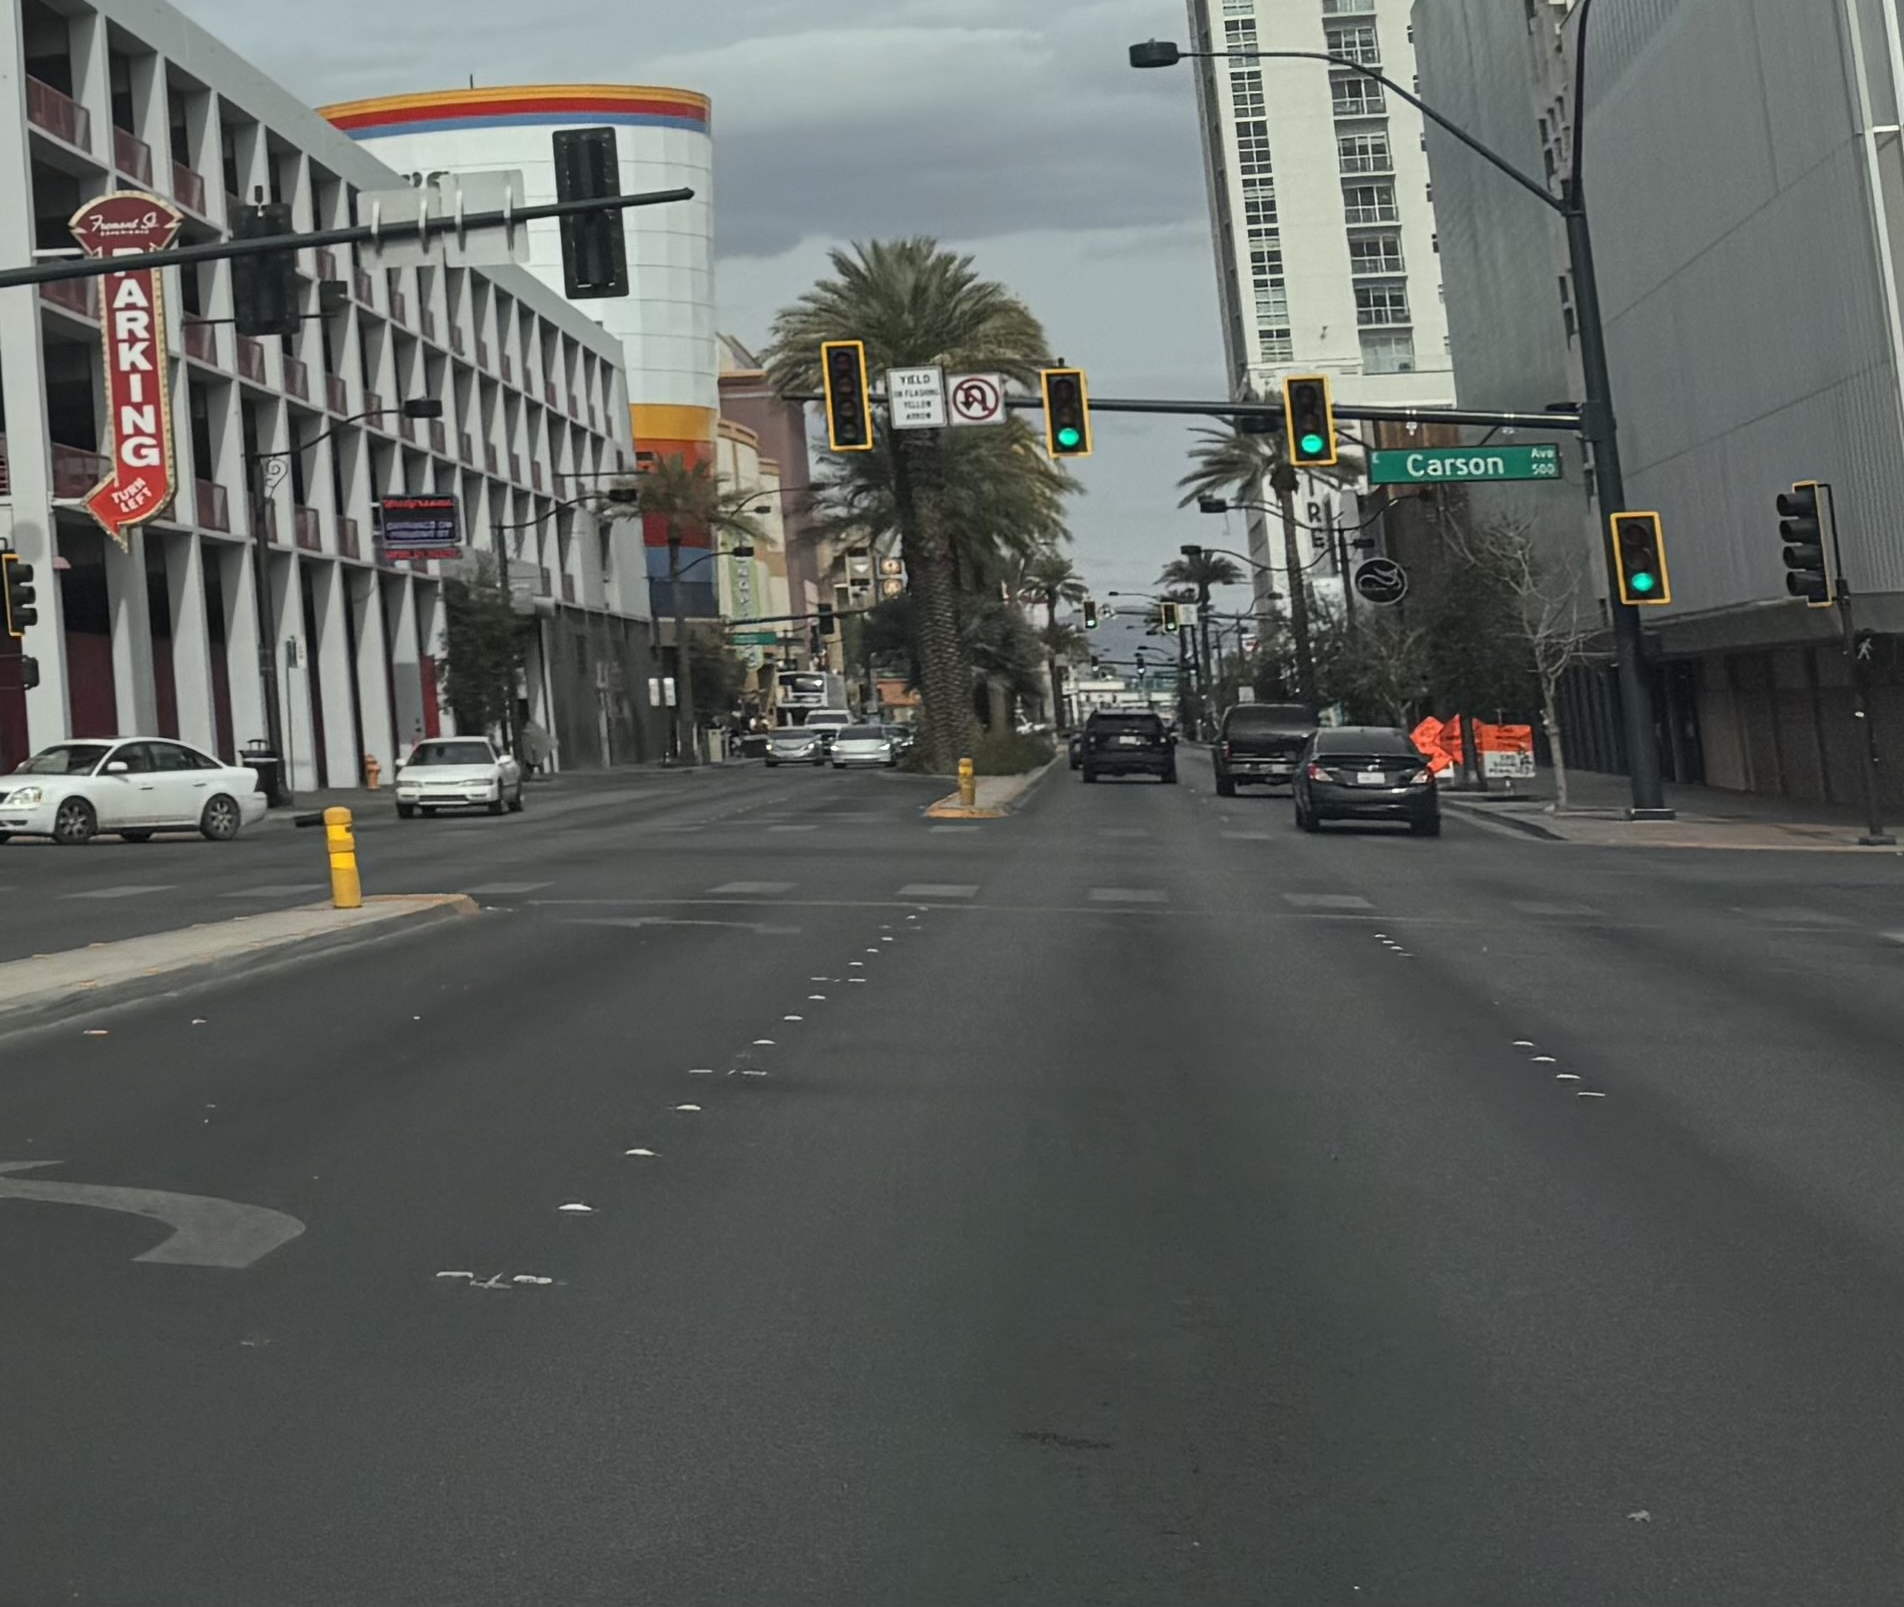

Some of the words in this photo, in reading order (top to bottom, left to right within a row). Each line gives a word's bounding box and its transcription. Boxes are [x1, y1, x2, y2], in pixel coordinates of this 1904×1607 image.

[900, 374, 931, 385] YIELD
[1406, 453, 1505, 477] Carson
[1531, 448, 1555, 459] Ave
[1531, 463, 1555, 475] 500
[111, 478, 146, 504] TURN
[120, 487, 153, 514] LEFT
